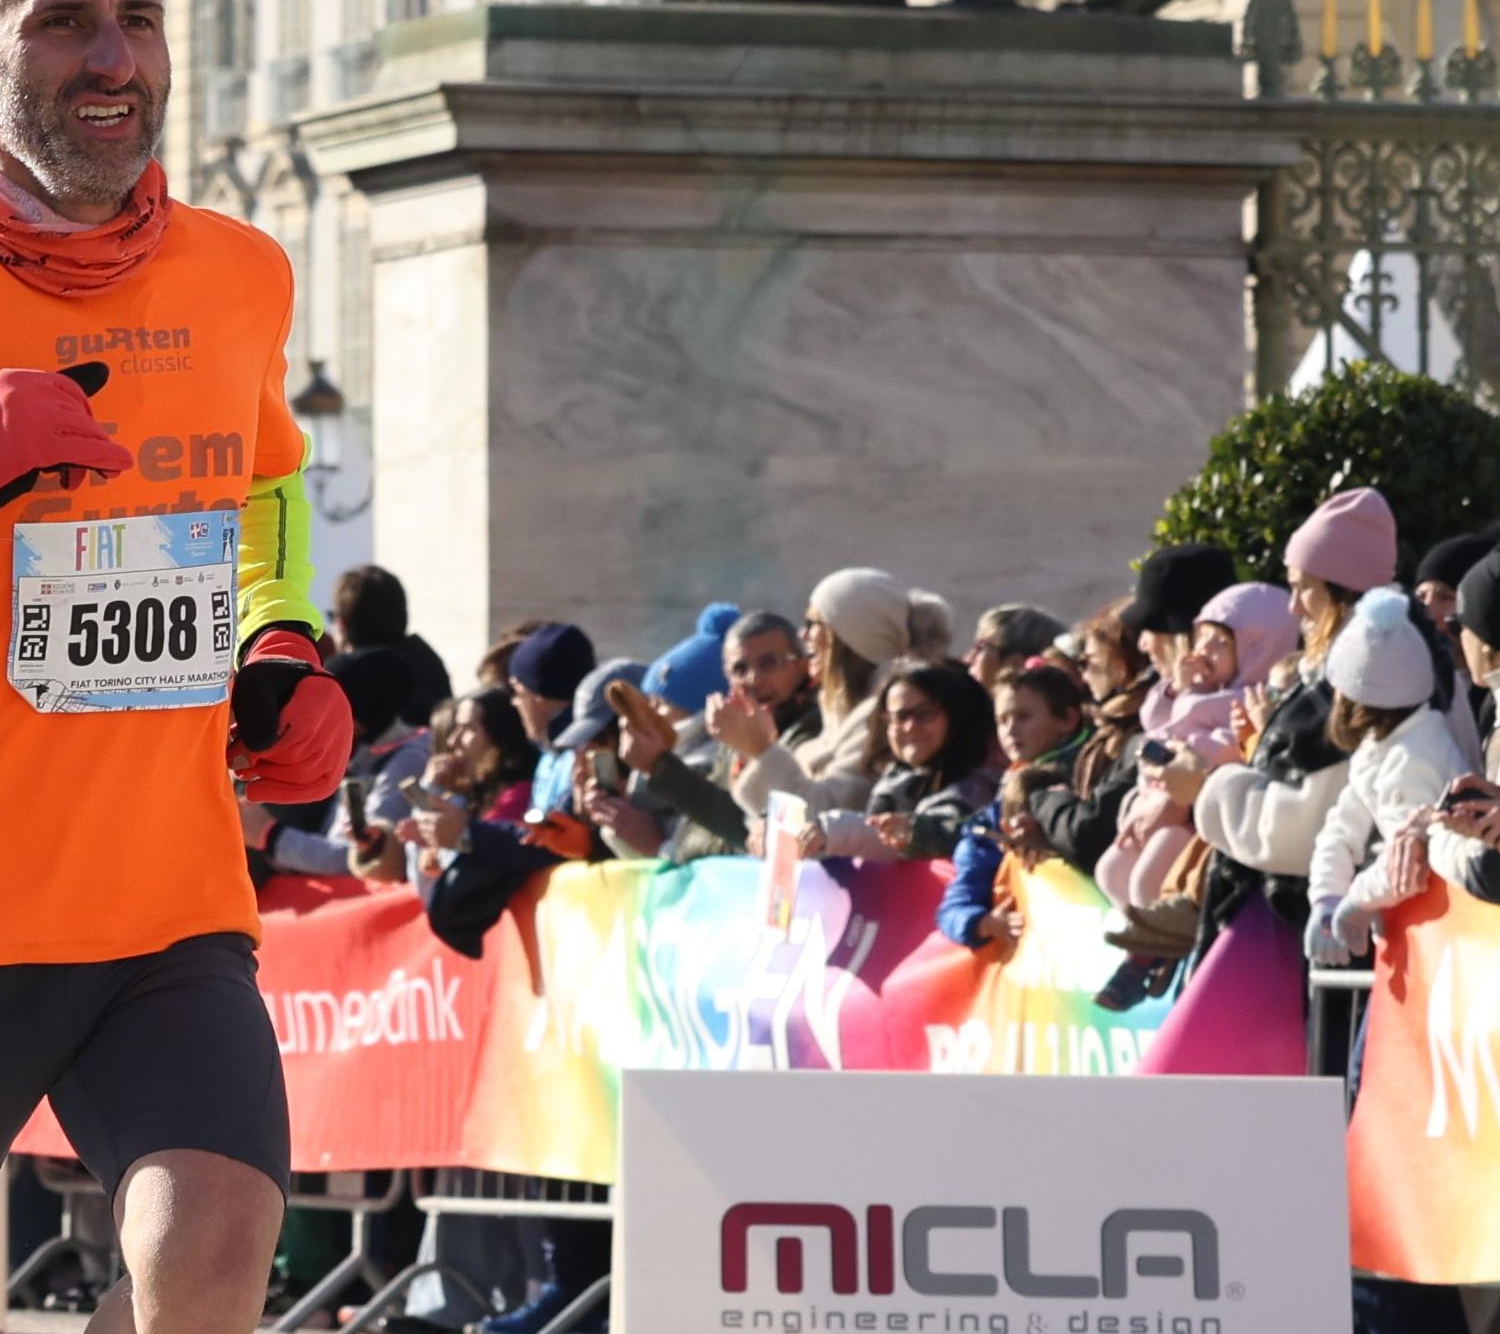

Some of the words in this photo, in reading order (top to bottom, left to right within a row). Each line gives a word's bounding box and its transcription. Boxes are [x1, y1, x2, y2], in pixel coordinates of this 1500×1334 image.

[120, 352, 193, 376] classic
[75, 524, 126, 572] FIAT
[67, 595, 198, 667] 5308
[70, 679, 91, 689] FIAT
[94, 677, 133, 688] TORINO
[134, 675, 157, 686] CITY
[159, 674, 185, 685] HALF
[720, 1201, 1221, 1301] MICLA
